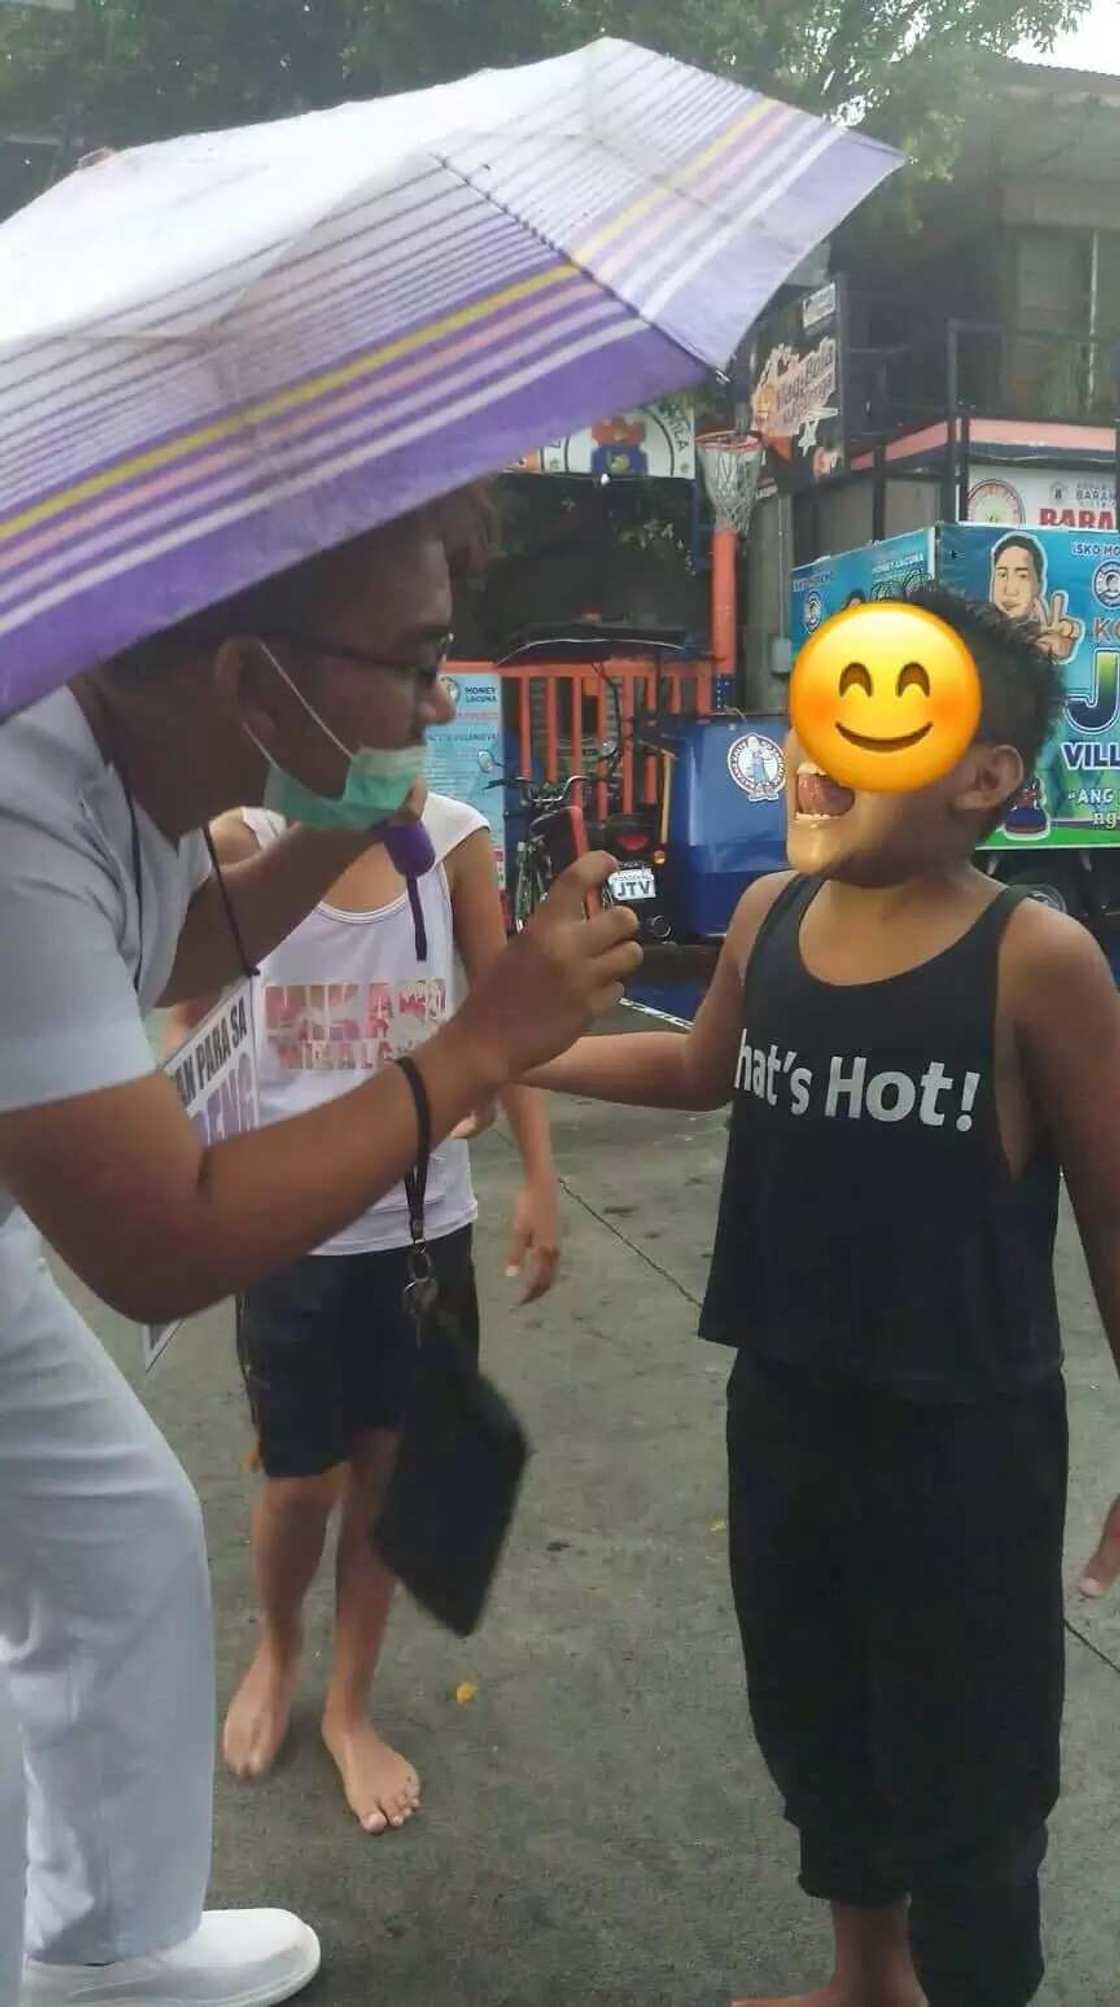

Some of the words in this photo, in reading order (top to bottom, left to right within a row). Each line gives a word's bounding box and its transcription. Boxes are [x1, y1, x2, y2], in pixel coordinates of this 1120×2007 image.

[1063, 648, 1120, 734] J
[617, 880, 650, 897] JTV
[196, 1013, 232, 1091] PARA
[230, 995, 248, 1050] SA
[824, 1055, 981, 1132] Hot!
